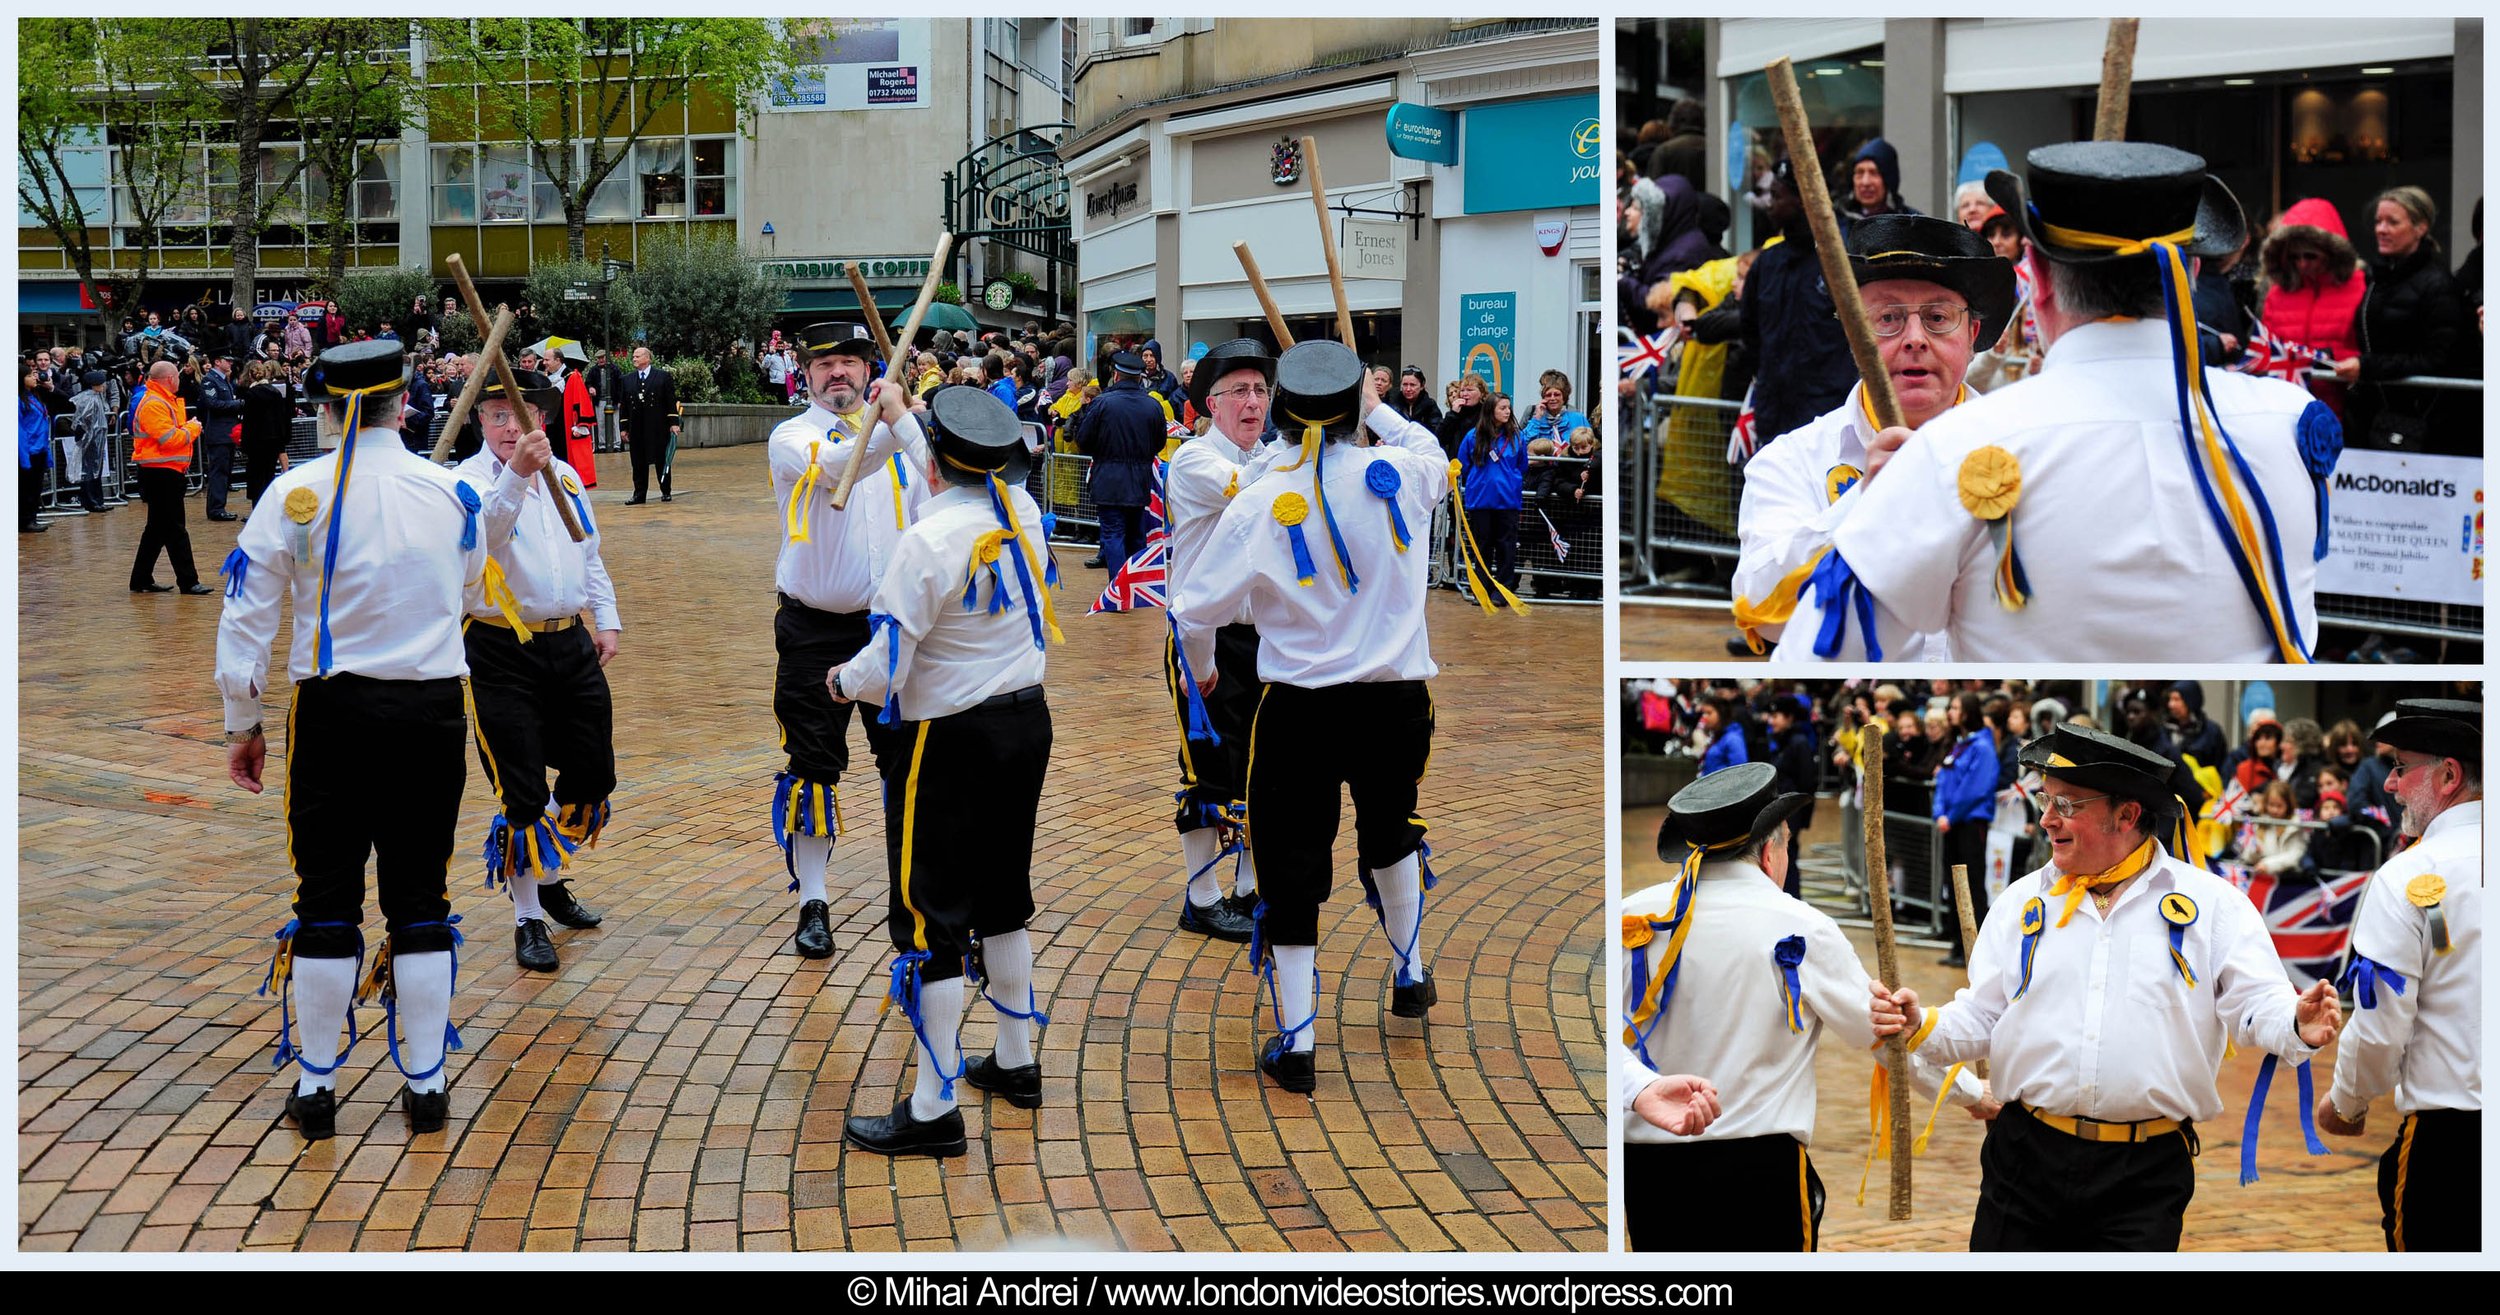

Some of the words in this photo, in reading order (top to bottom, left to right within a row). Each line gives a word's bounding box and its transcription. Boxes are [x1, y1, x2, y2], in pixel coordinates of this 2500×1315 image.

[869, 70, 899, 78] Michael
[880, 78, 906, 88] Rogers
[869, 89, 890, 97] 01732
[891, 88, 916, 96] 740000
[1403, 123, 1442, 139] eurochange
[1354, 226, 1396, 249] Ernest
[1538, 227, 1561, 236] KINGS
[1356, 248, 1395, 269] Jones
[761, 261, 870, 278] TARBUCS
[872, 260, 933, 277] COFFE
[1469, 298, 1508, 310] bureau
[1480, 312, 1495, 324] de
[1466, 325, 1509, 338] change
[2335, 472, 2457, 498] McDonald's
[2333, 514, 2363, 525] Wishes
[2375, 520, 2429, 532] congratulate
[2337, 530, 2383, 544] MAJESTY
[2386, 533, 2406, 545] THE
[2409, 537, 2449, 549] QUEEN
[2357, 546, 2398, 559] Diamond
[2400, 550, 2430, 561] Jubilee
